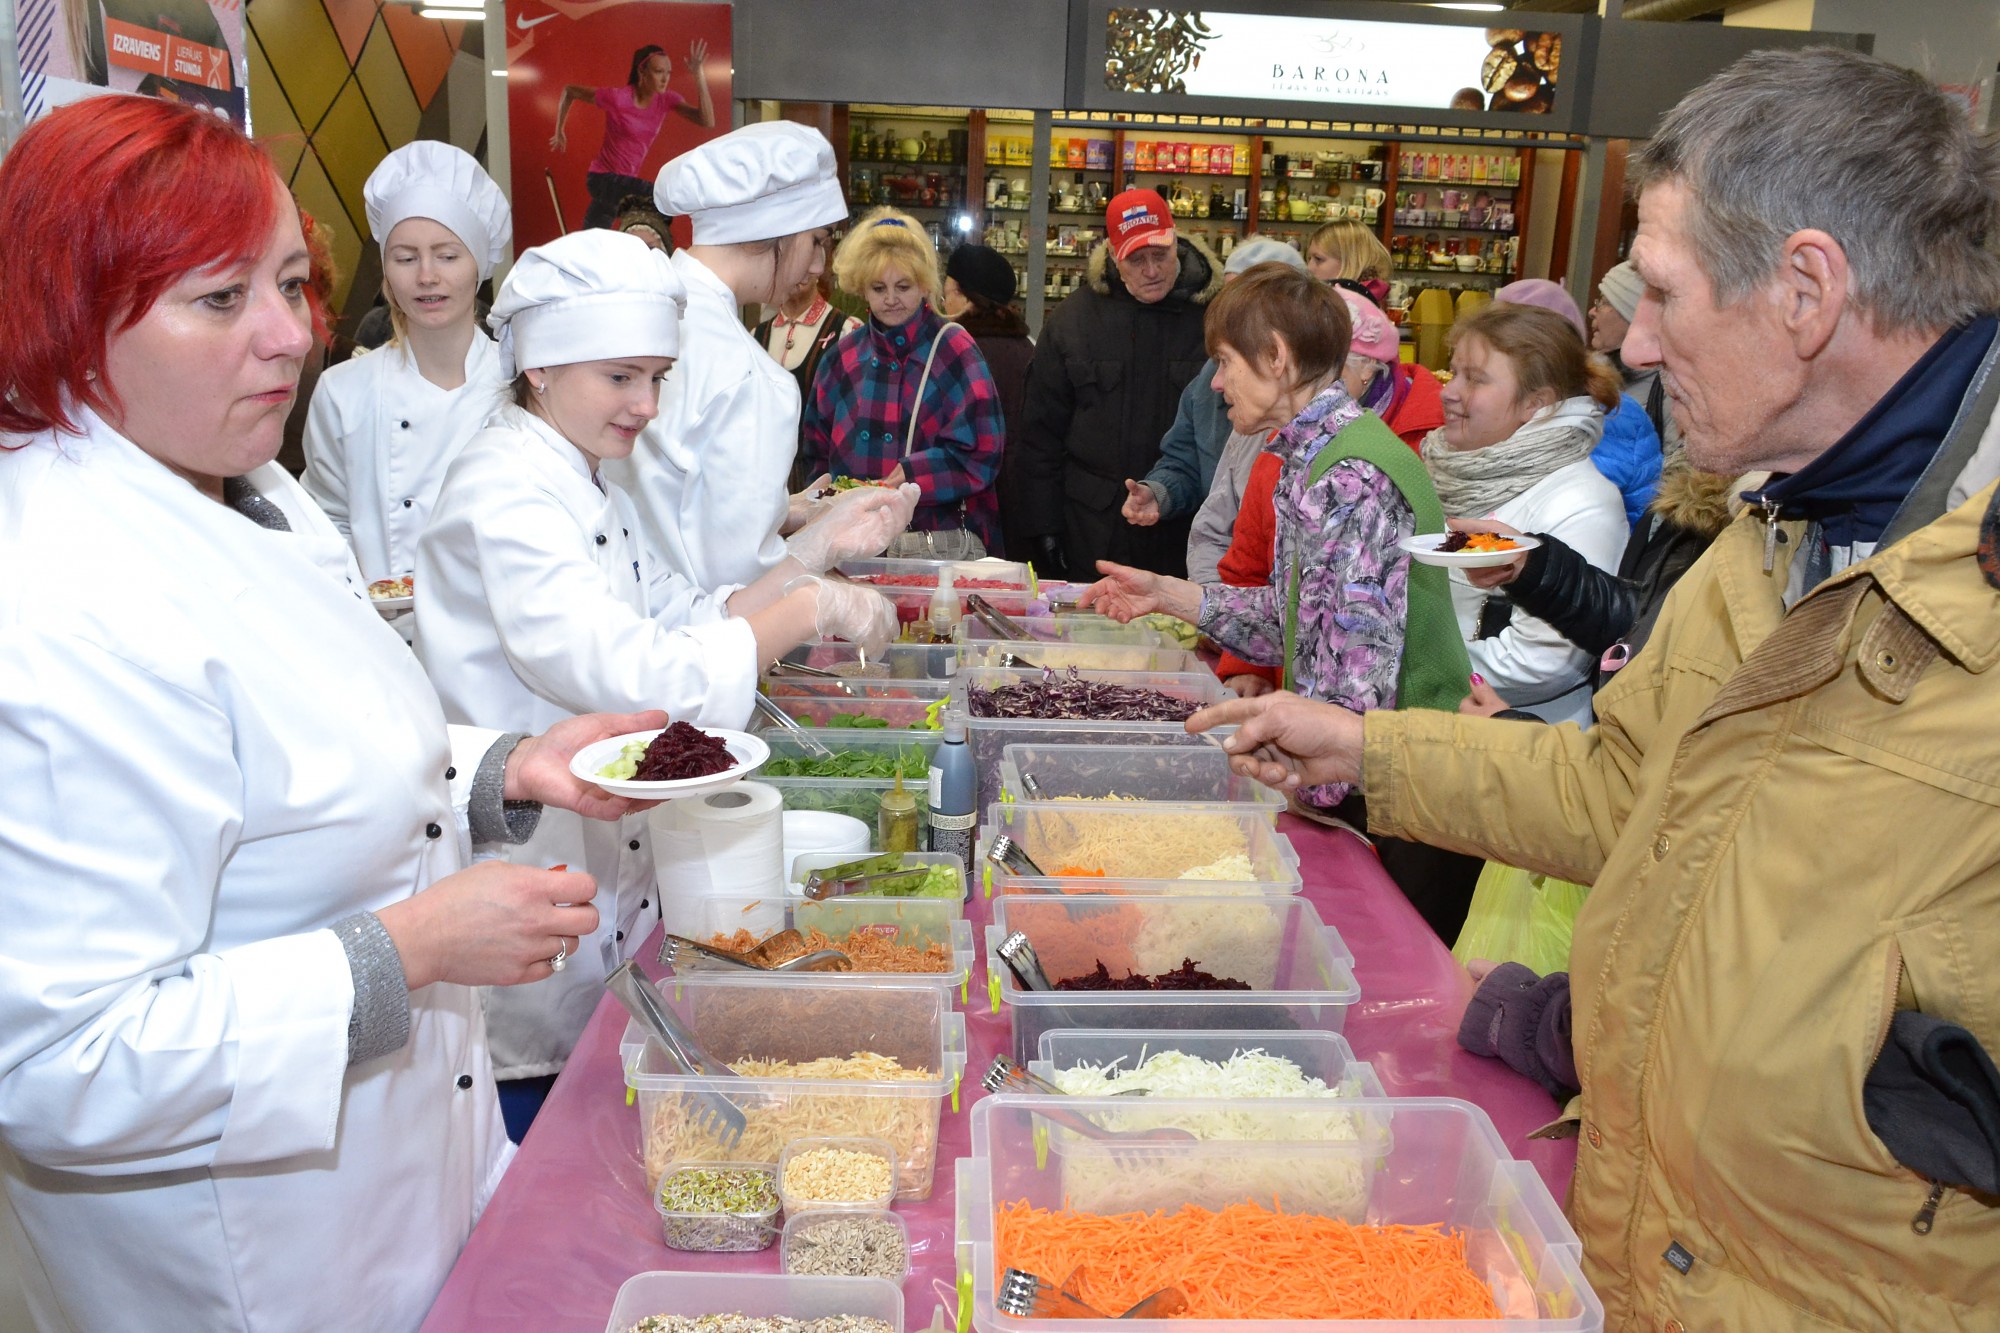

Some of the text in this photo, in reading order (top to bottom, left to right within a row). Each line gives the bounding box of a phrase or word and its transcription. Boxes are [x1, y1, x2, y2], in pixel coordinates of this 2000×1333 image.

[113, 33, 161, 61] IZRAVIENS
[174, 59, 202, 78] STUNDA
[1272, 63, 1388, 84] BARONA
